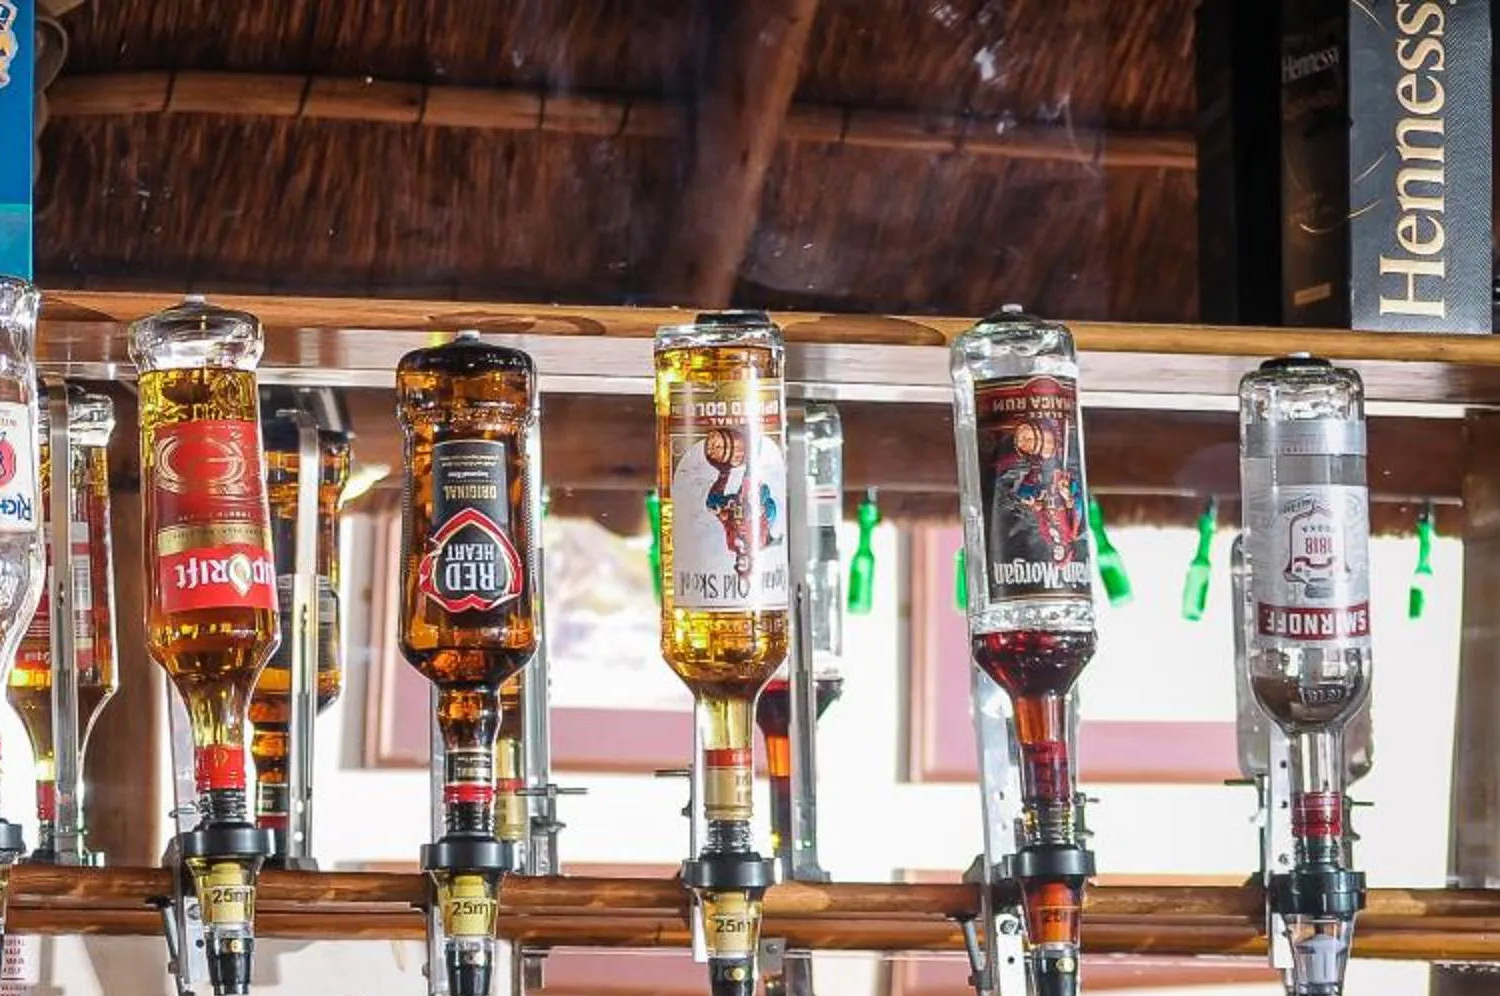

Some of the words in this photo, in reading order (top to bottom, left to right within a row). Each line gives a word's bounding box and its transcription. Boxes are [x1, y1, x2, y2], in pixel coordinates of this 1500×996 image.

[993, 397, 1026, 412] RUM
[1029, 411, 1063, 419] BLACK
[443, 485, 497, 499] ORIGINAL
[445, 543, 495, 561] HEART
[445, 562, 496, 591] RED
[993, 557, 1063, 589] Morgan
[1266, 609, 1367, 635] SMRNOFF
